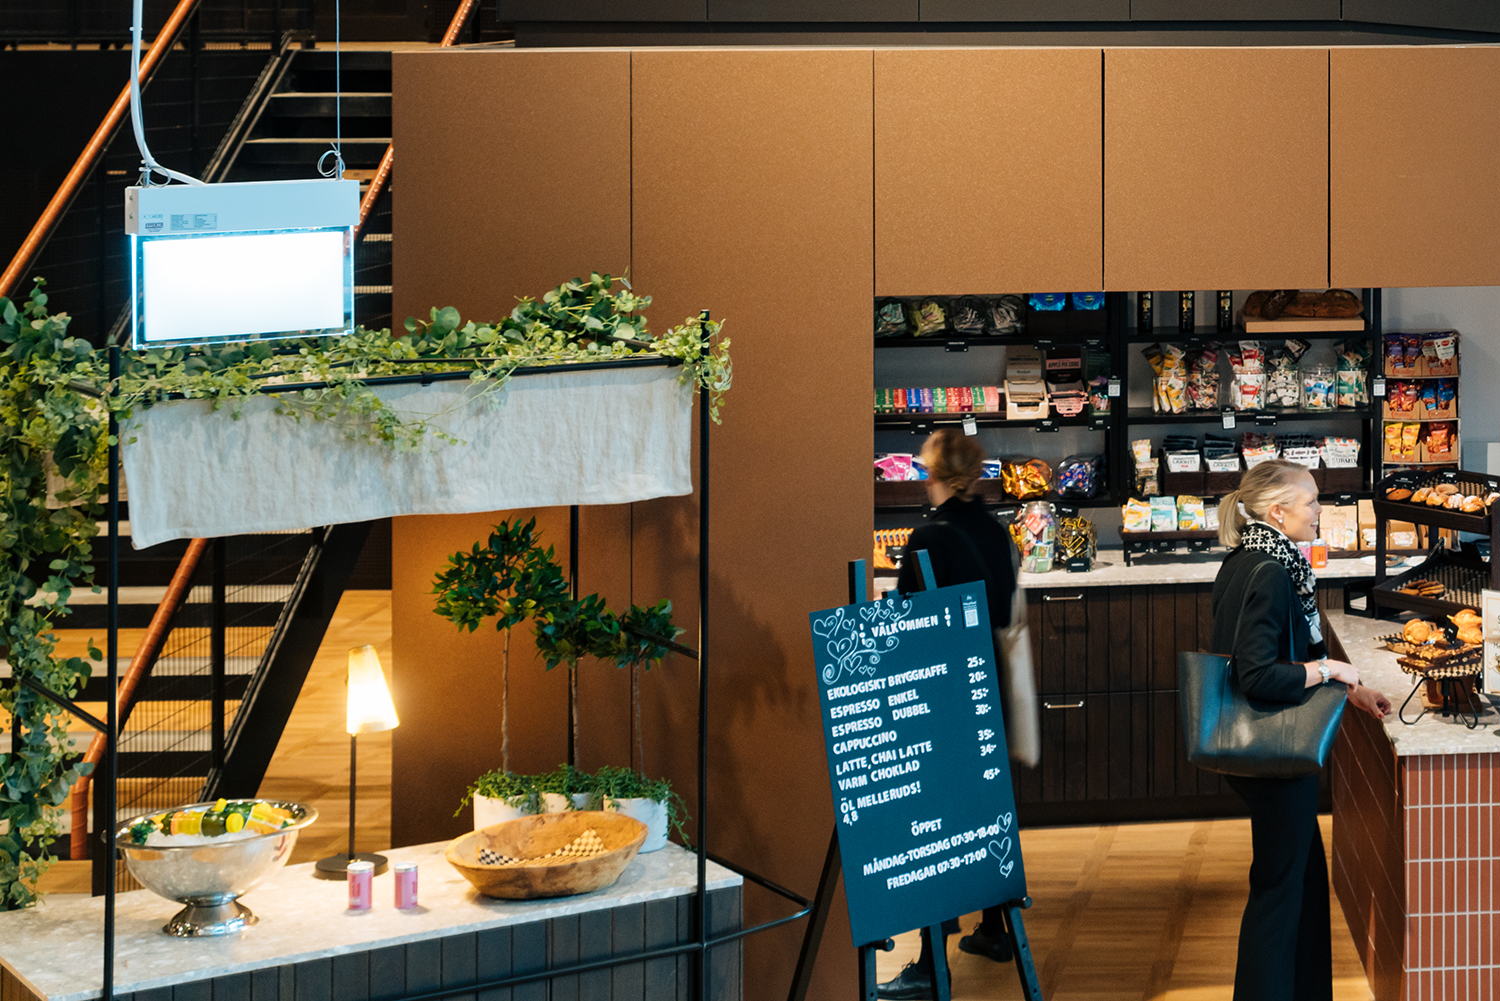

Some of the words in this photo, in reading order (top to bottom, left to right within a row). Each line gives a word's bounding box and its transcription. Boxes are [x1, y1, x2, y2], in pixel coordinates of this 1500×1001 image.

[871, 615, 939, 638] VÄLKOMMEN
[827, 678, 887, 701] EKOLOGISKT
[888, 663, 948, 688] BRYGGKAFFE
[830, 698, 880, 719] ESPRESSO
[888, 688, 919, 707] ENKEL
[831, 716, 883, 738] ESPRESSO
[892, 702, 931, 721] DUBBEL
[833, 730, 897, 755] CAPPUCCINO
[899, 740, 933, 759] LATTE
[838, 775, 868, 791] VARM
[870, 759, 920, 782] CHOKLAD
[840, 797, 855, 814] ÖL
[857, 781, 921, 809] MELLERUDS!
[842, 810, 859, 826] 4,8
[911, 818, 942, 836] ÖPPET
[863, 838, 951, 876] MÅNDAG-TORSDAG
[887, 864, 937, 890] FREDAGAR
